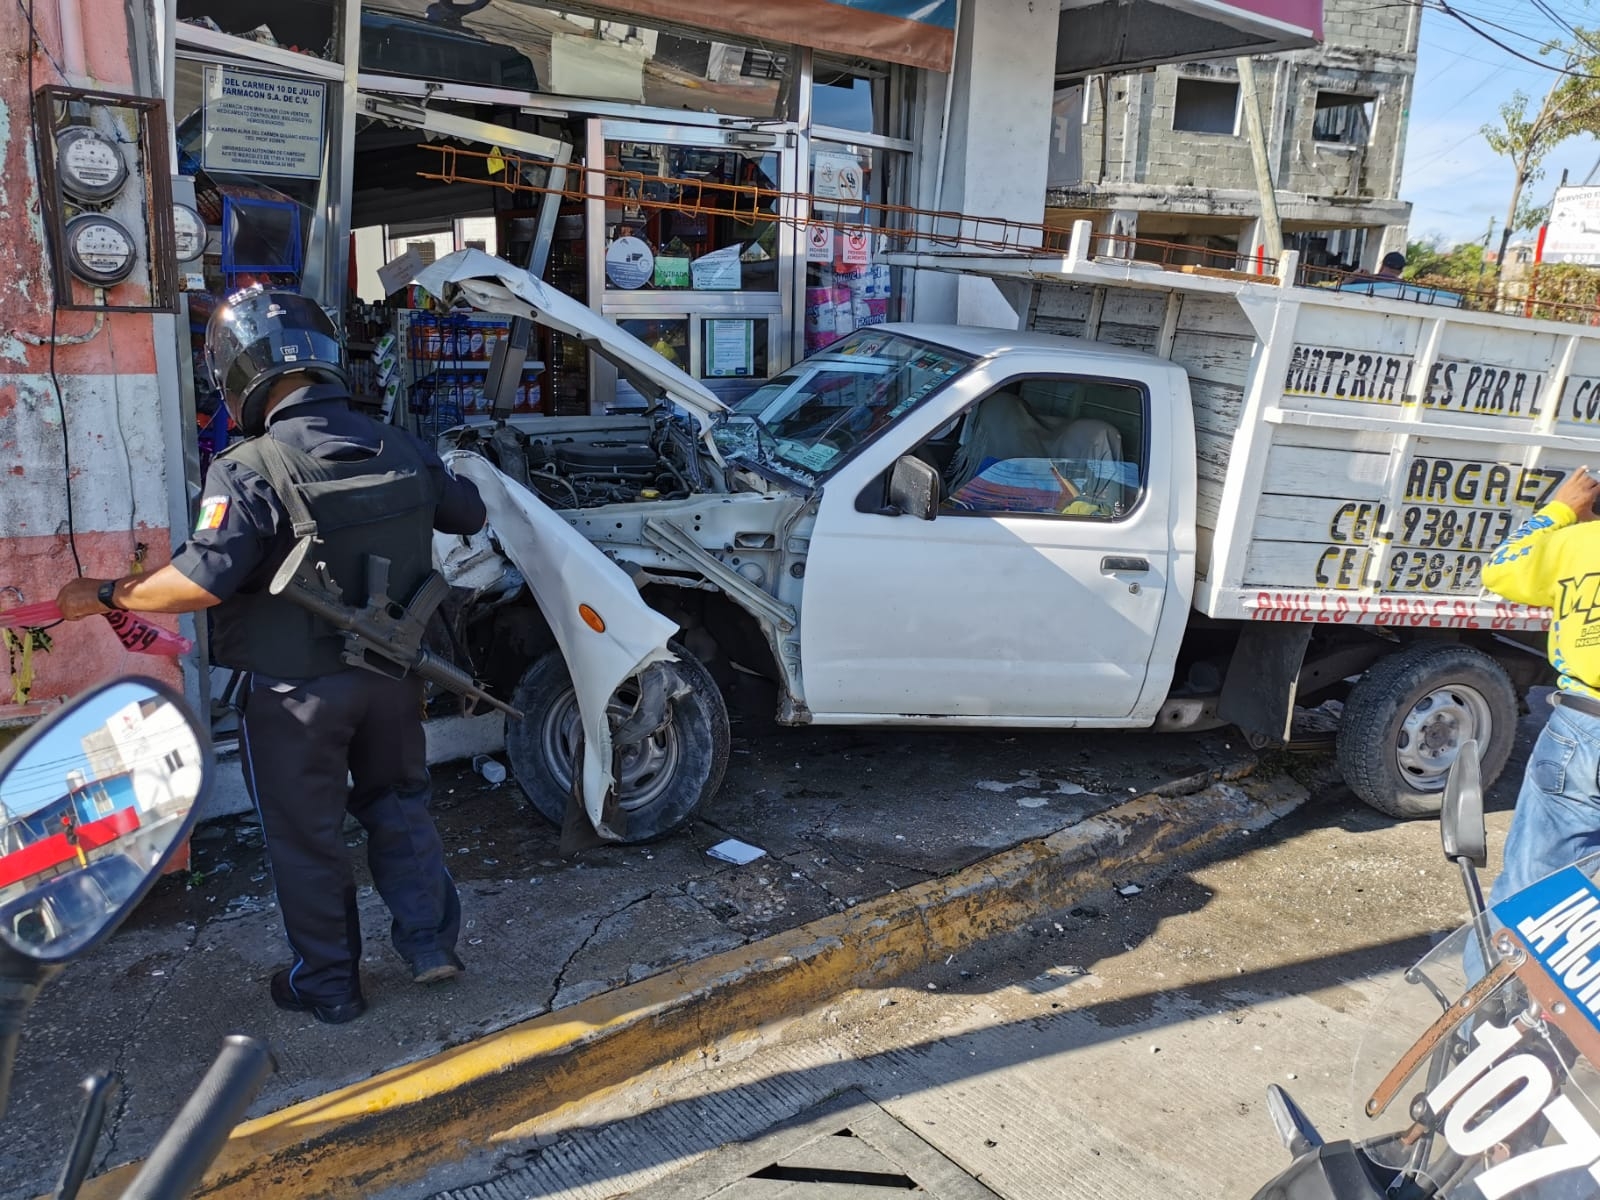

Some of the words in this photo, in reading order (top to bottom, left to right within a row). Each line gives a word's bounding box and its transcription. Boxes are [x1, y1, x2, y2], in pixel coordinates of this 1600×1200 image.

[222, 86, 265, 99] FARMACON
[267, 92, 282, 102] S.A.
[283, 94, 294, 103] DE
[295, 96, 309, 105] C.V.
[224, 77, 240, 87] DEL
[242, 80, 275, 91] CARMEN
[277, 84, 286, 93] 10
[287, 86, 298, 95] DE
[299, 88, 321, 98] JULIO
[1285, 346, 1458, 406] MATERIALES
[1405, 458, 1566, 511] ARGAEZ
[1253, 592, 1350, 623] ANILLO
[1356, 597, 1371, 623] Y
[1374, 598, 1480, 629] BROCAL
[1491, 603, 1520, 629] DE
